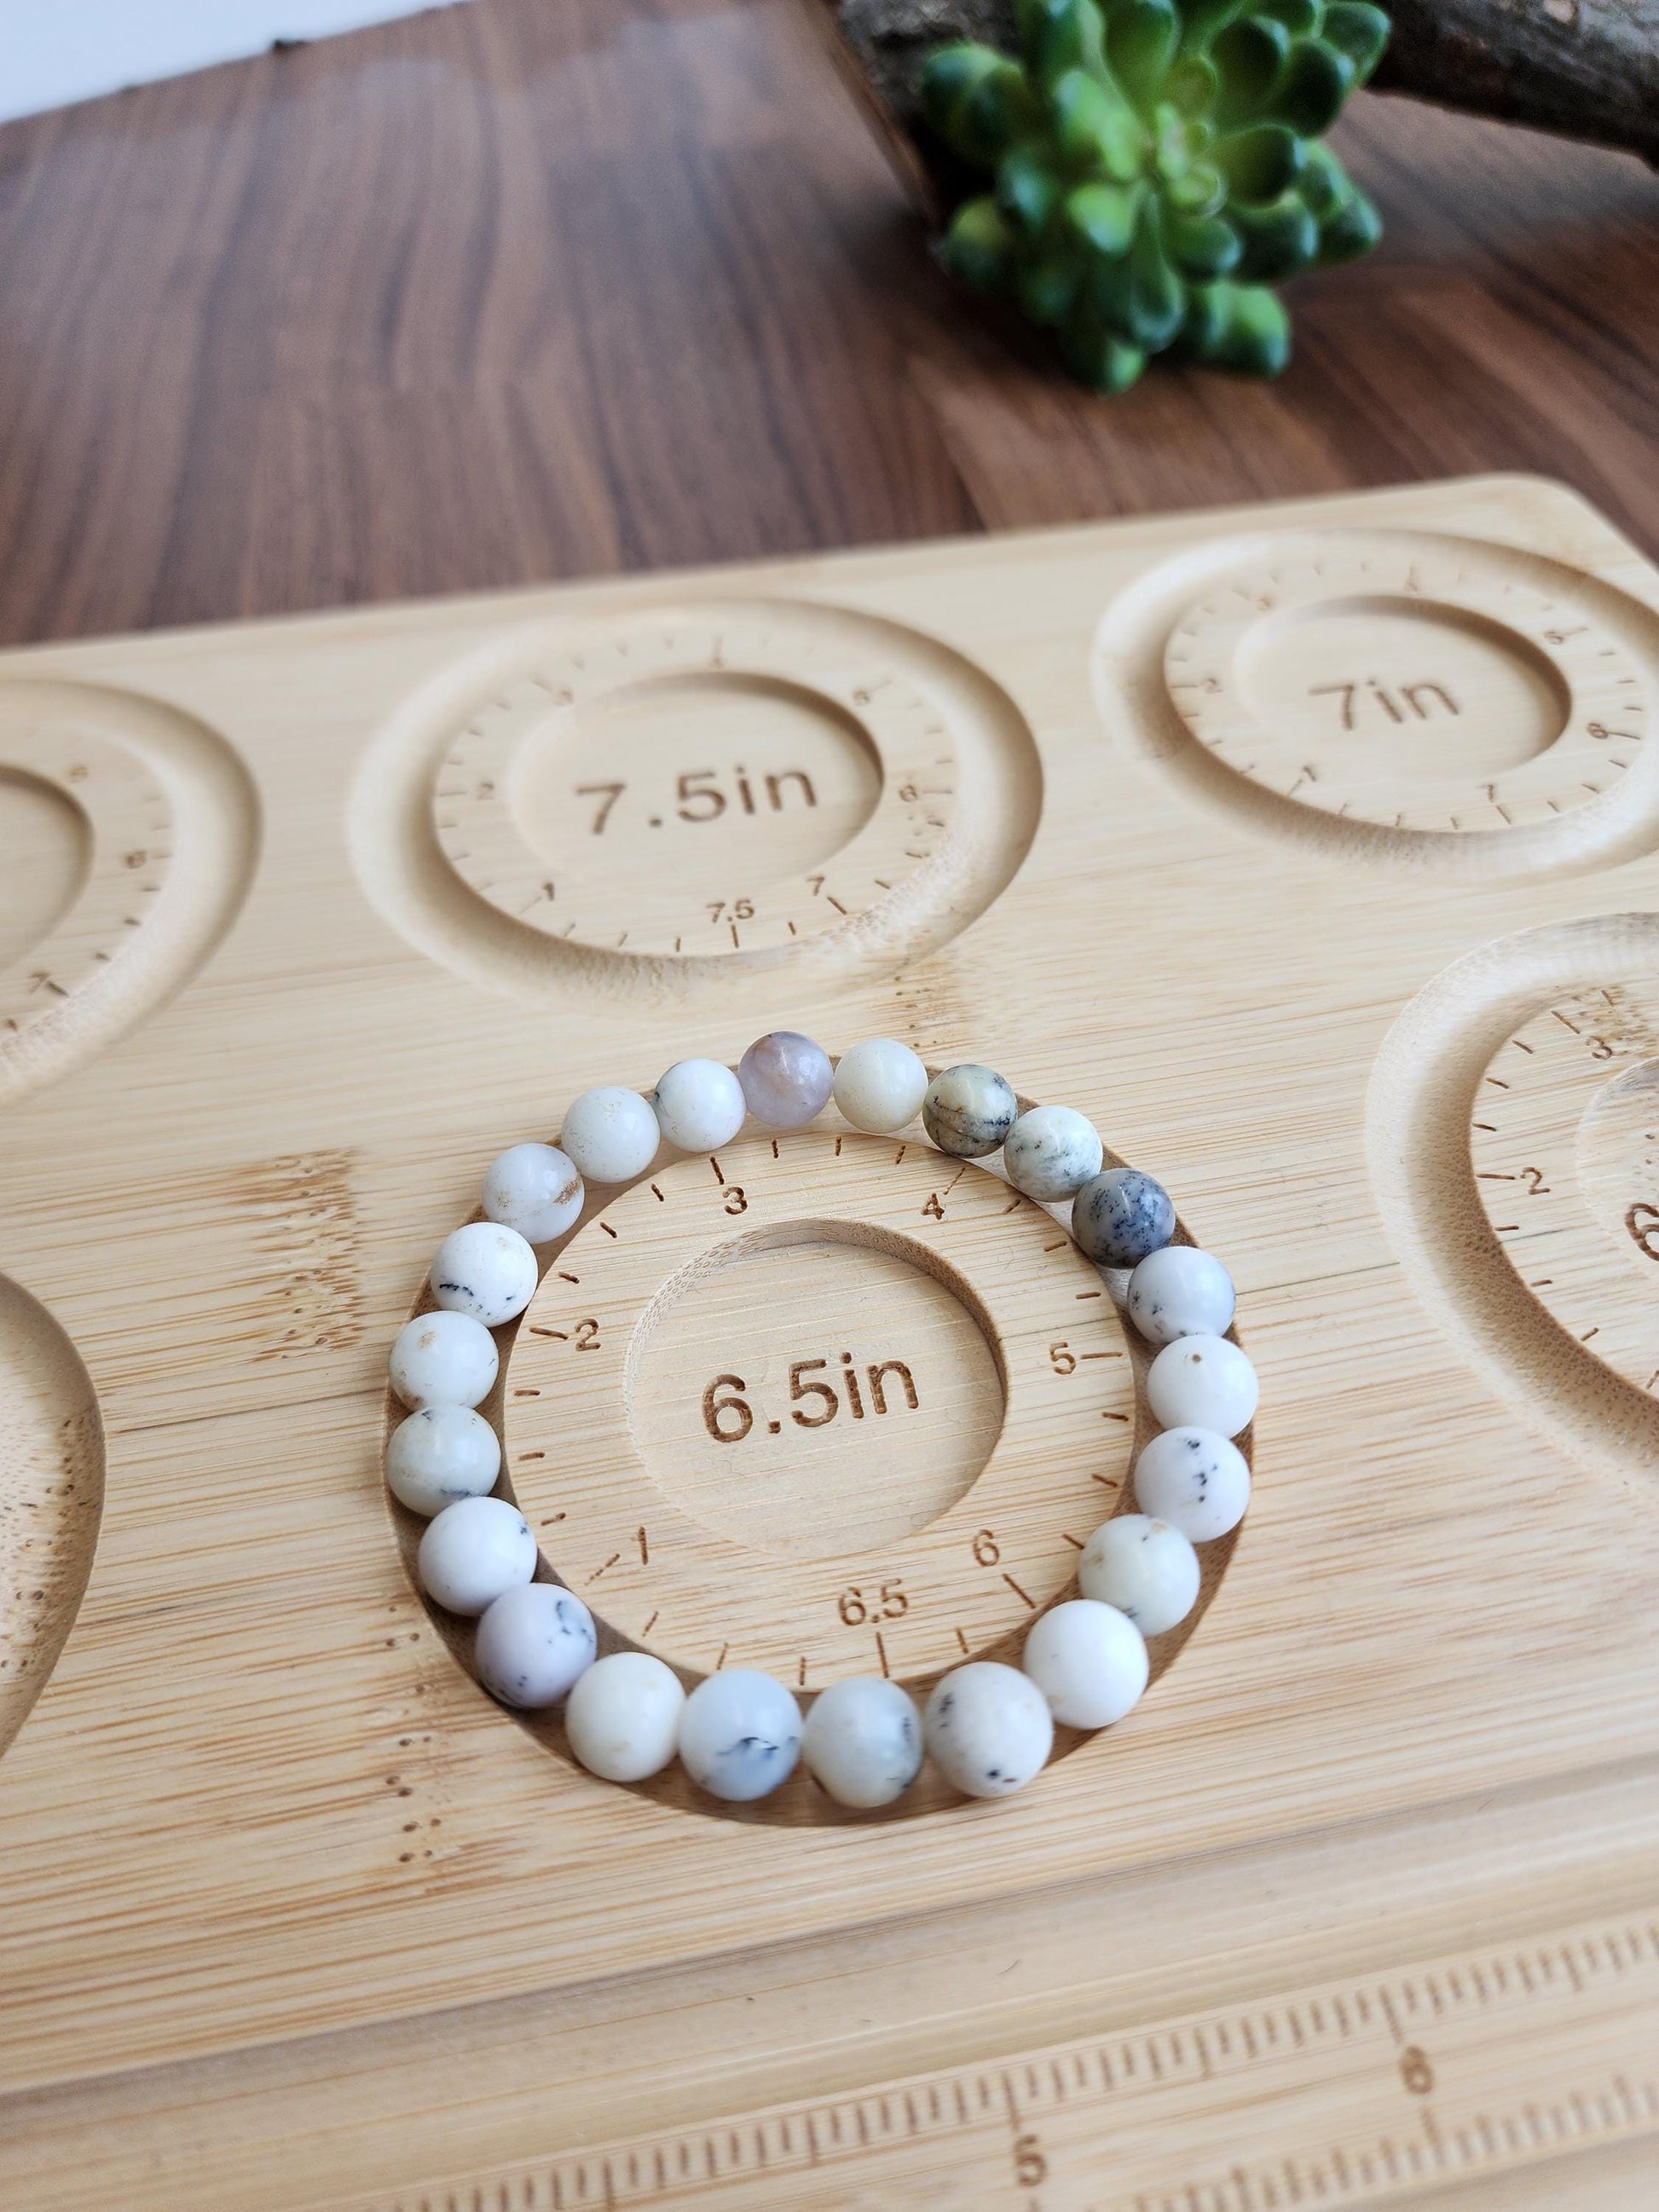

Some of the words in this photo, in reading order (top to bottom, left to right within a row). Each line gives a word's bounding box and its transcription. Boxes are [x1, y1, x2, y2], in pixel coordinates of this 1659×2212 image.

[1308, 679, 1459, 731] 7in
[1587, 722, 1609, 740] 6
[575, 765, 818, 835] 7.5in
[806, 876, 825, 897] 7
[706, 898, 755, 924] 7.5
[1586, 1036, 1613, 1060] 3
[1520, 1166, 1550, 1195] 2
[722, 1187, 749, 1215] 3
[921, 1192, 945, 1220] 4
[574, 1318, 601, 1351] 2
[1049, 1342, 1077, 1375] 5
[702, 1351, 918, 1443] 6.5in
[632, 1526, 649, 1564] 1
[972, 1528, 1001, 1568] 6
[838, 1579, 909, 1626] 6.5
[1014, 2134, 1047, 2187] 5
